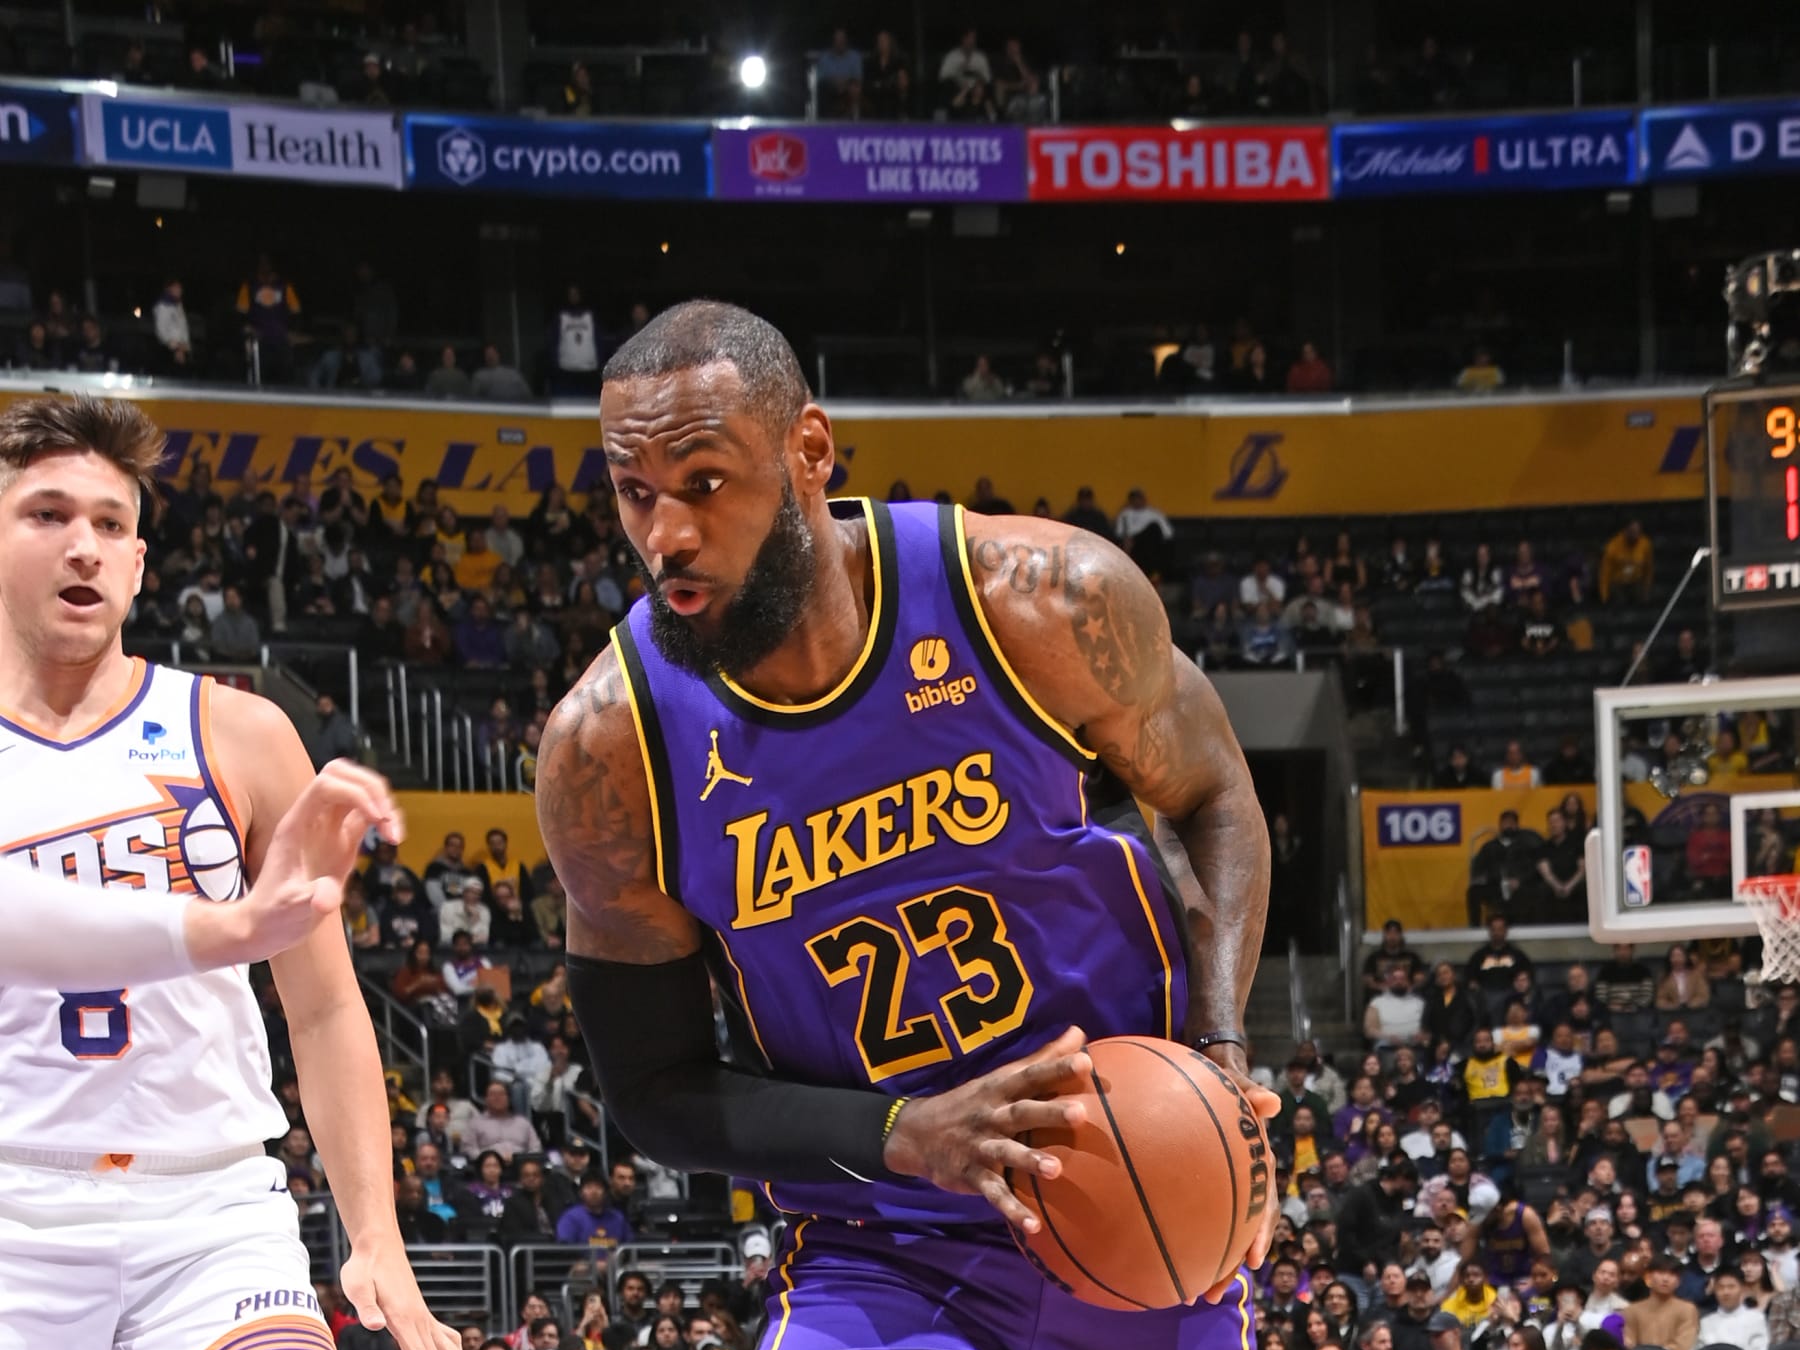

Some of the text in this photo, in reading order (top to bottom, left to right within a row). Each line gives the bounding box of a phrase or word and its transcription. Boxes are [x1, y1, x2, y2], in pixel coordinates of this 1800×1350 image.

[121, 116, 382, 170] UCLA Health
[836, 137, 1003, 163] VICTORY TASTES
[1498, 134, 1622, 169] ULTRA
[1730, 119, 1800, 162] DE
[493, 145, 681, 177] crypto.com
[866, 166, 980, 193] LIKE TACOS
[1040, 140, 1315, 189] TOSHIBA
[904, 675, 977, 714] bibigo
[128, 748, 186, 762] PayPal
[725, 752, 1010, 931] LAKERS
[1384, 808, 1455, 843] 106
[803, 884, 1035, 1085] 23
[58, 986, 133, 1061] 8
